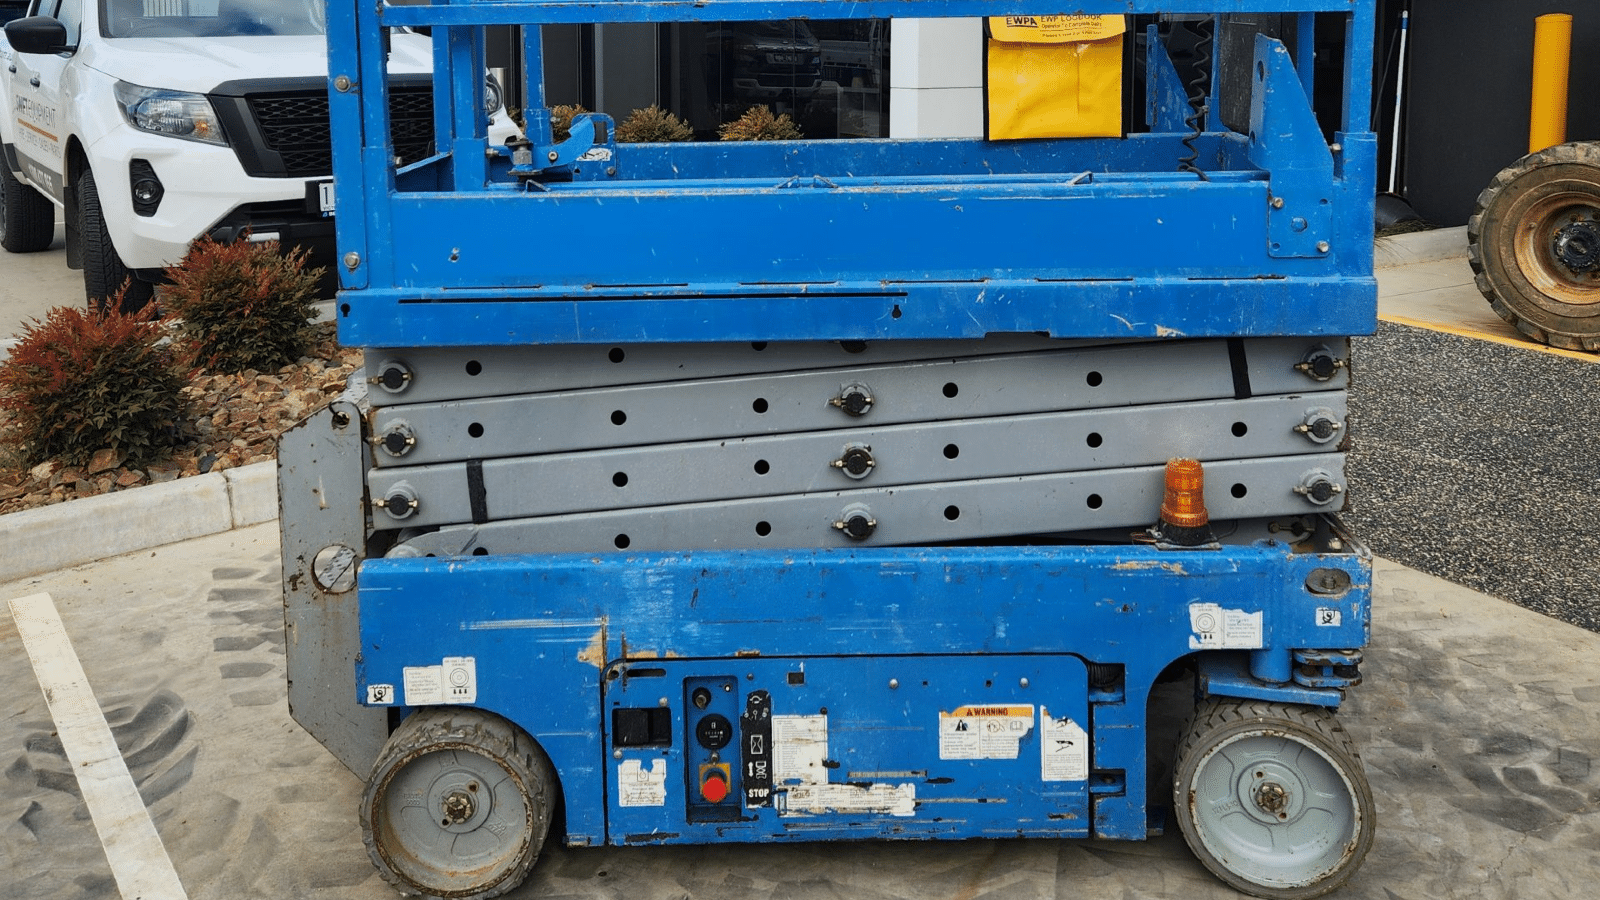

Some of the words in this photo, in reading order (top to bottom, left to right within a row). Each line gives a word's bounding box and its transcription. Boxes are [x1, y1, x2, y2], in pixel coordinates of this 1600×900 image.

[1006, 16, 1038, 26] EWPA
[973, 707, 1008, 717] WARNING
[748, 788, 770, 798] STOP
